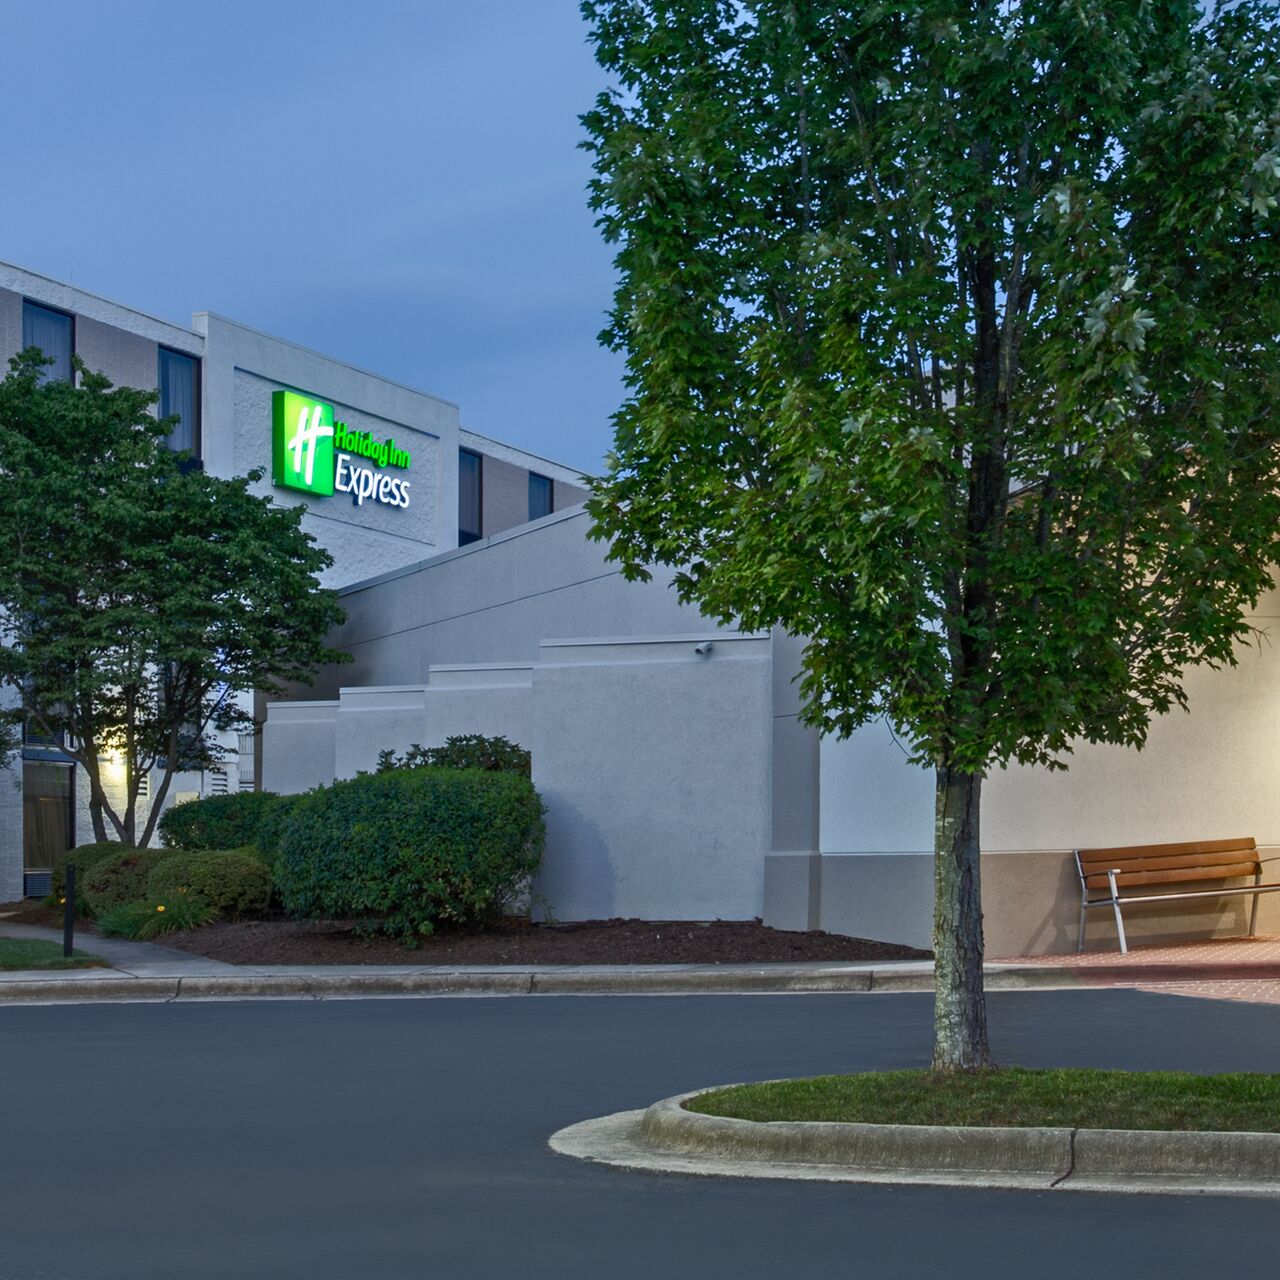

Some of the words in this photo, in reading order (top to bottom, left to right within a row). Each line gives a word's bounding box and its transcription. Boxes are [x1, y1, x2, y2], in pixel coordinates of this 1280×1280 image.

[334, 421, 389, 467] Holiday
[389, 439, 411, 468] Inn
[335, 453, 410, 508] Express
